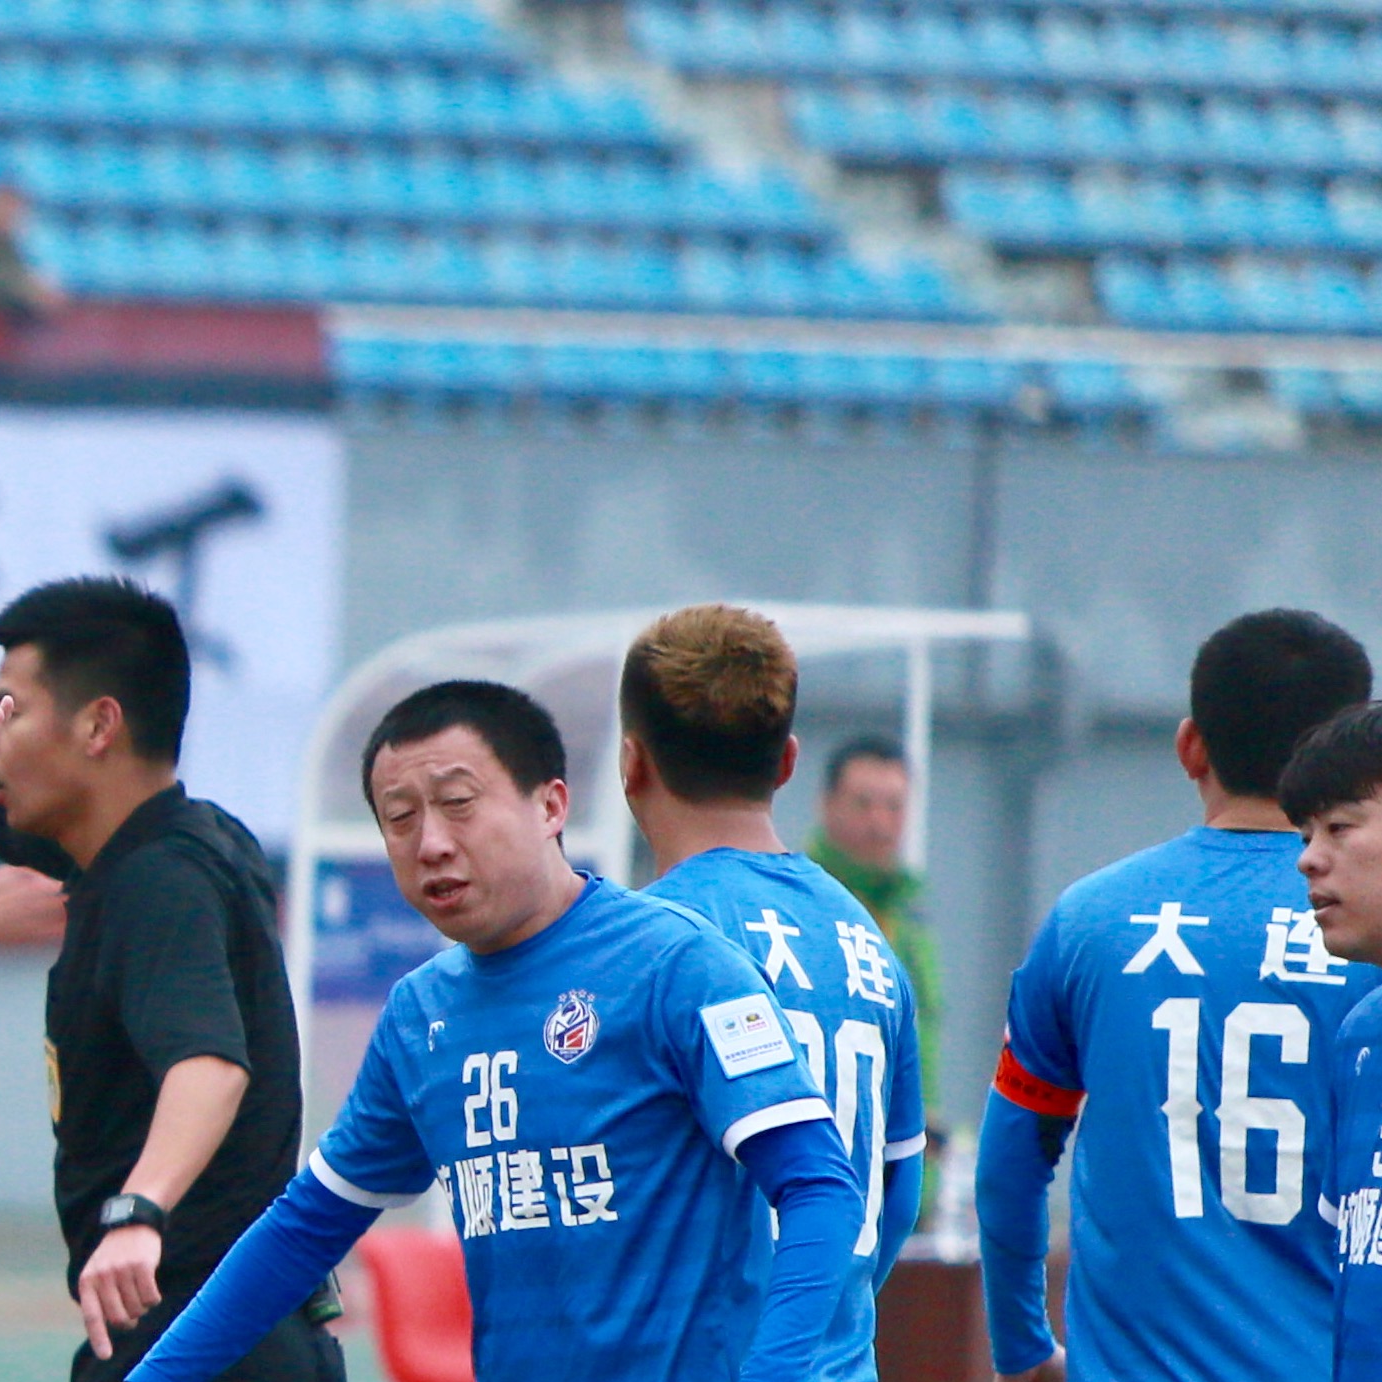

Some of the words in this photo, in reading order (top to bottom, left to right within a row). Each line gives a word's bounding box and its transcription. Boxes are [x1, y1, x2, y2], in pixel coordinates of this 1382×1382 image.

[745, 908, 896, 1010] 大连
[1122, 902, 1348, 986] 大连
[462, 1050, 519, 1148] 26
[1152, 998, 1310, 1226] 16
